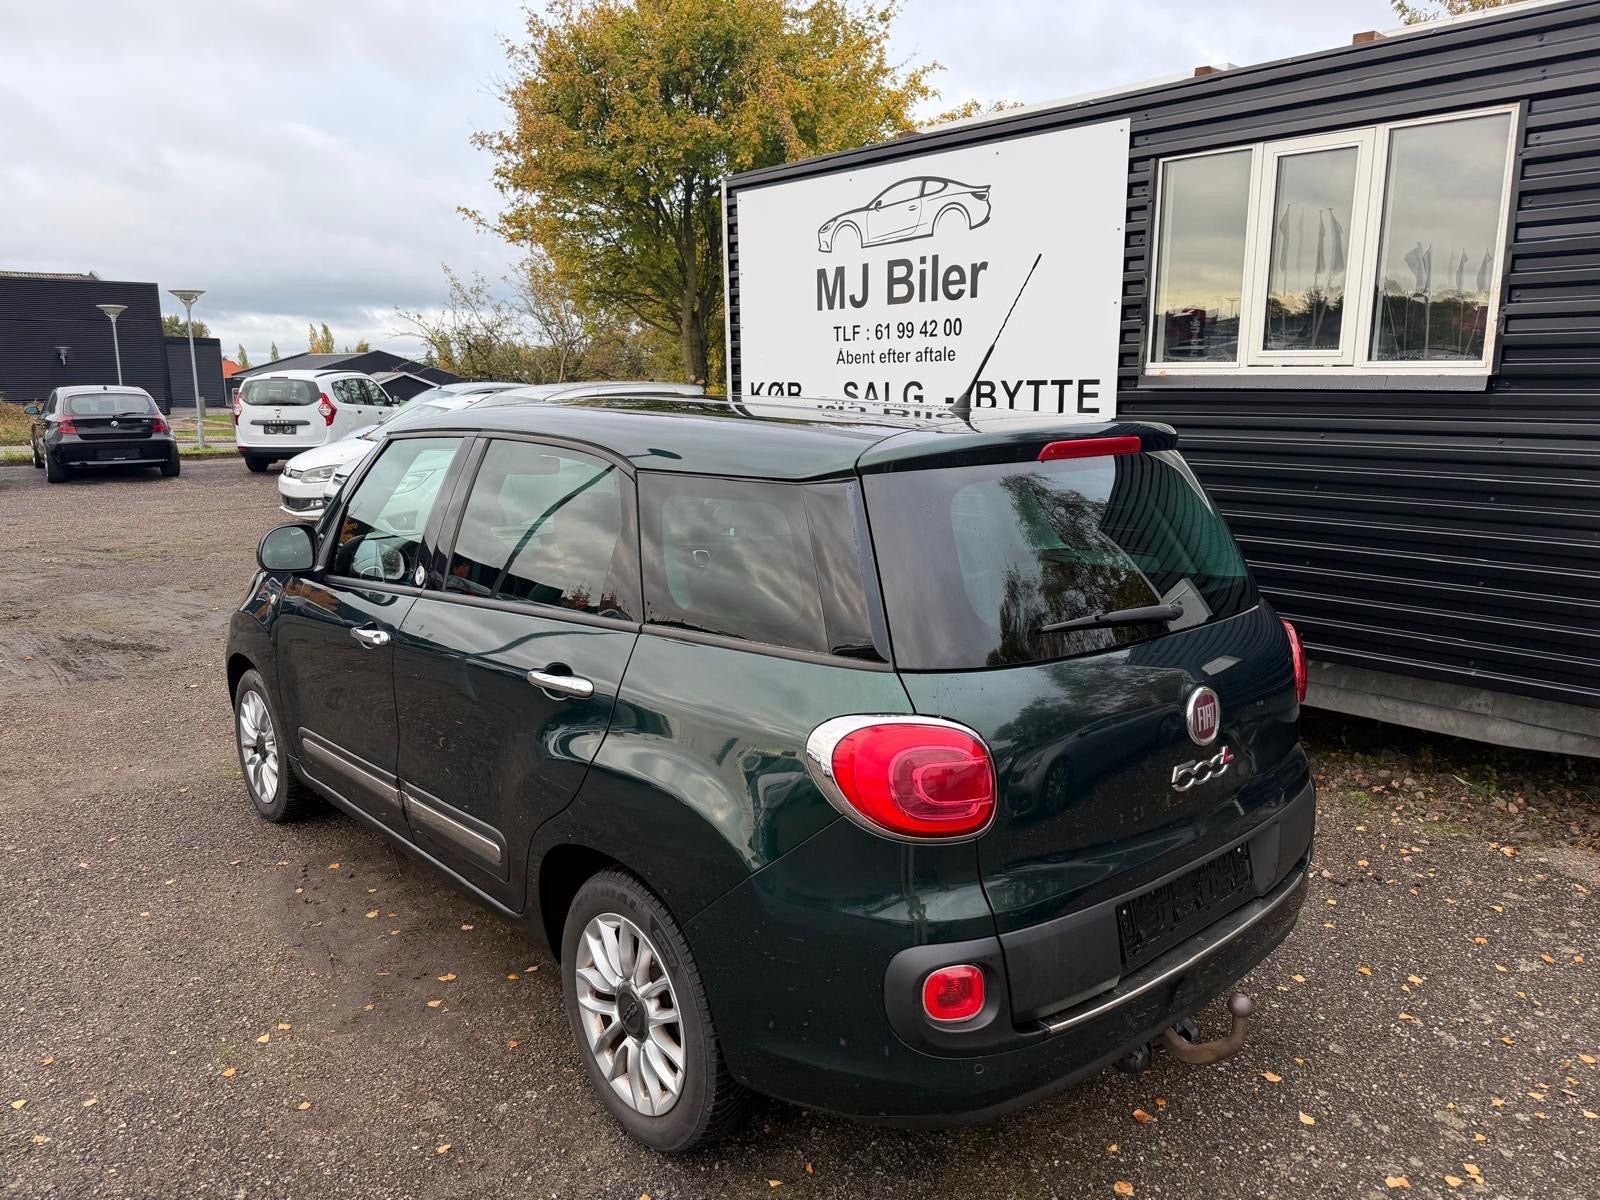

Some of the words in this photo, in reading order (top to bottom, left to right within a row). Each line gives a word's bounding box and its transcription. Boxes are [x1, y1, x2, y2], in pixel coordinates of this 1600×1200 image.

[817, 263, 868, 311] MJ
[887, 254, 988, 305] Biler
[833, 325, 860, 342] TLF
[875, 323, 890, 340] 61
[897, 322, 914, 339] 99
[920, 320, 937, 337] 42
[944, 318, 962, 336] 00
[837, 348, 875, 364] Åbent
[879, 348, 911, 363] efter
[916, 346, 955, 362] aftale
[976, 379, 1100, 413] BYTTE
[1197, 702, 1215, 732] FIAT
